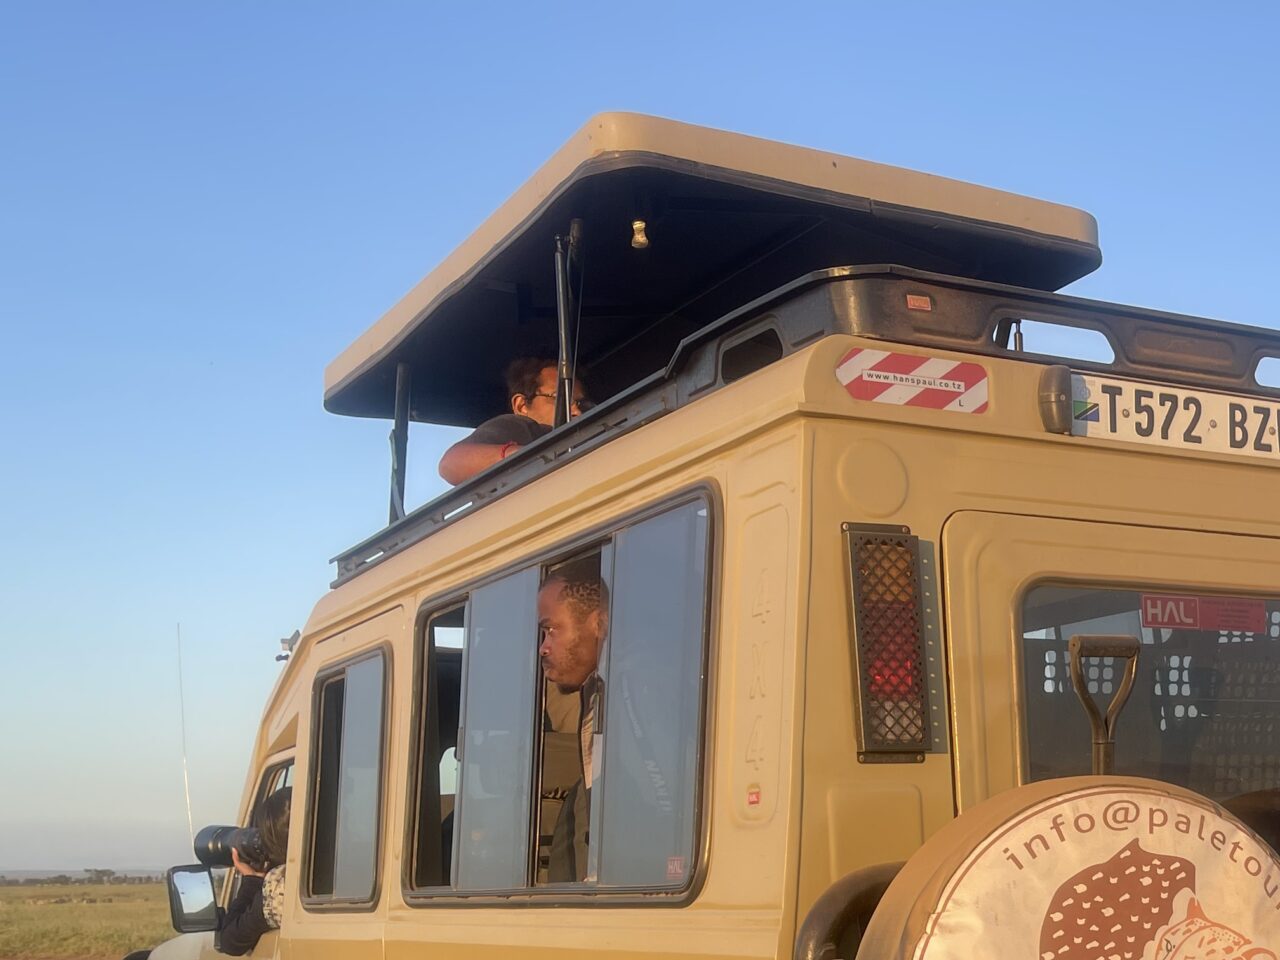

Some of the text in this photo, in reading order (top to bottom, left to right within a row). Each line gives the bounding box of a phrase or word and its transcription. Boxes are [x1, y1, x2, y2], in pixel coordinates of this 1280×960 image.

[866, 371, 962, 390] www.hanspaul.co.tz
[958, 399, 964, 407] L
[1101, 384, 1123, 433] T
[1134, 389, 1202, 444] 572
[1146, 598, 1194, 624] HAL
